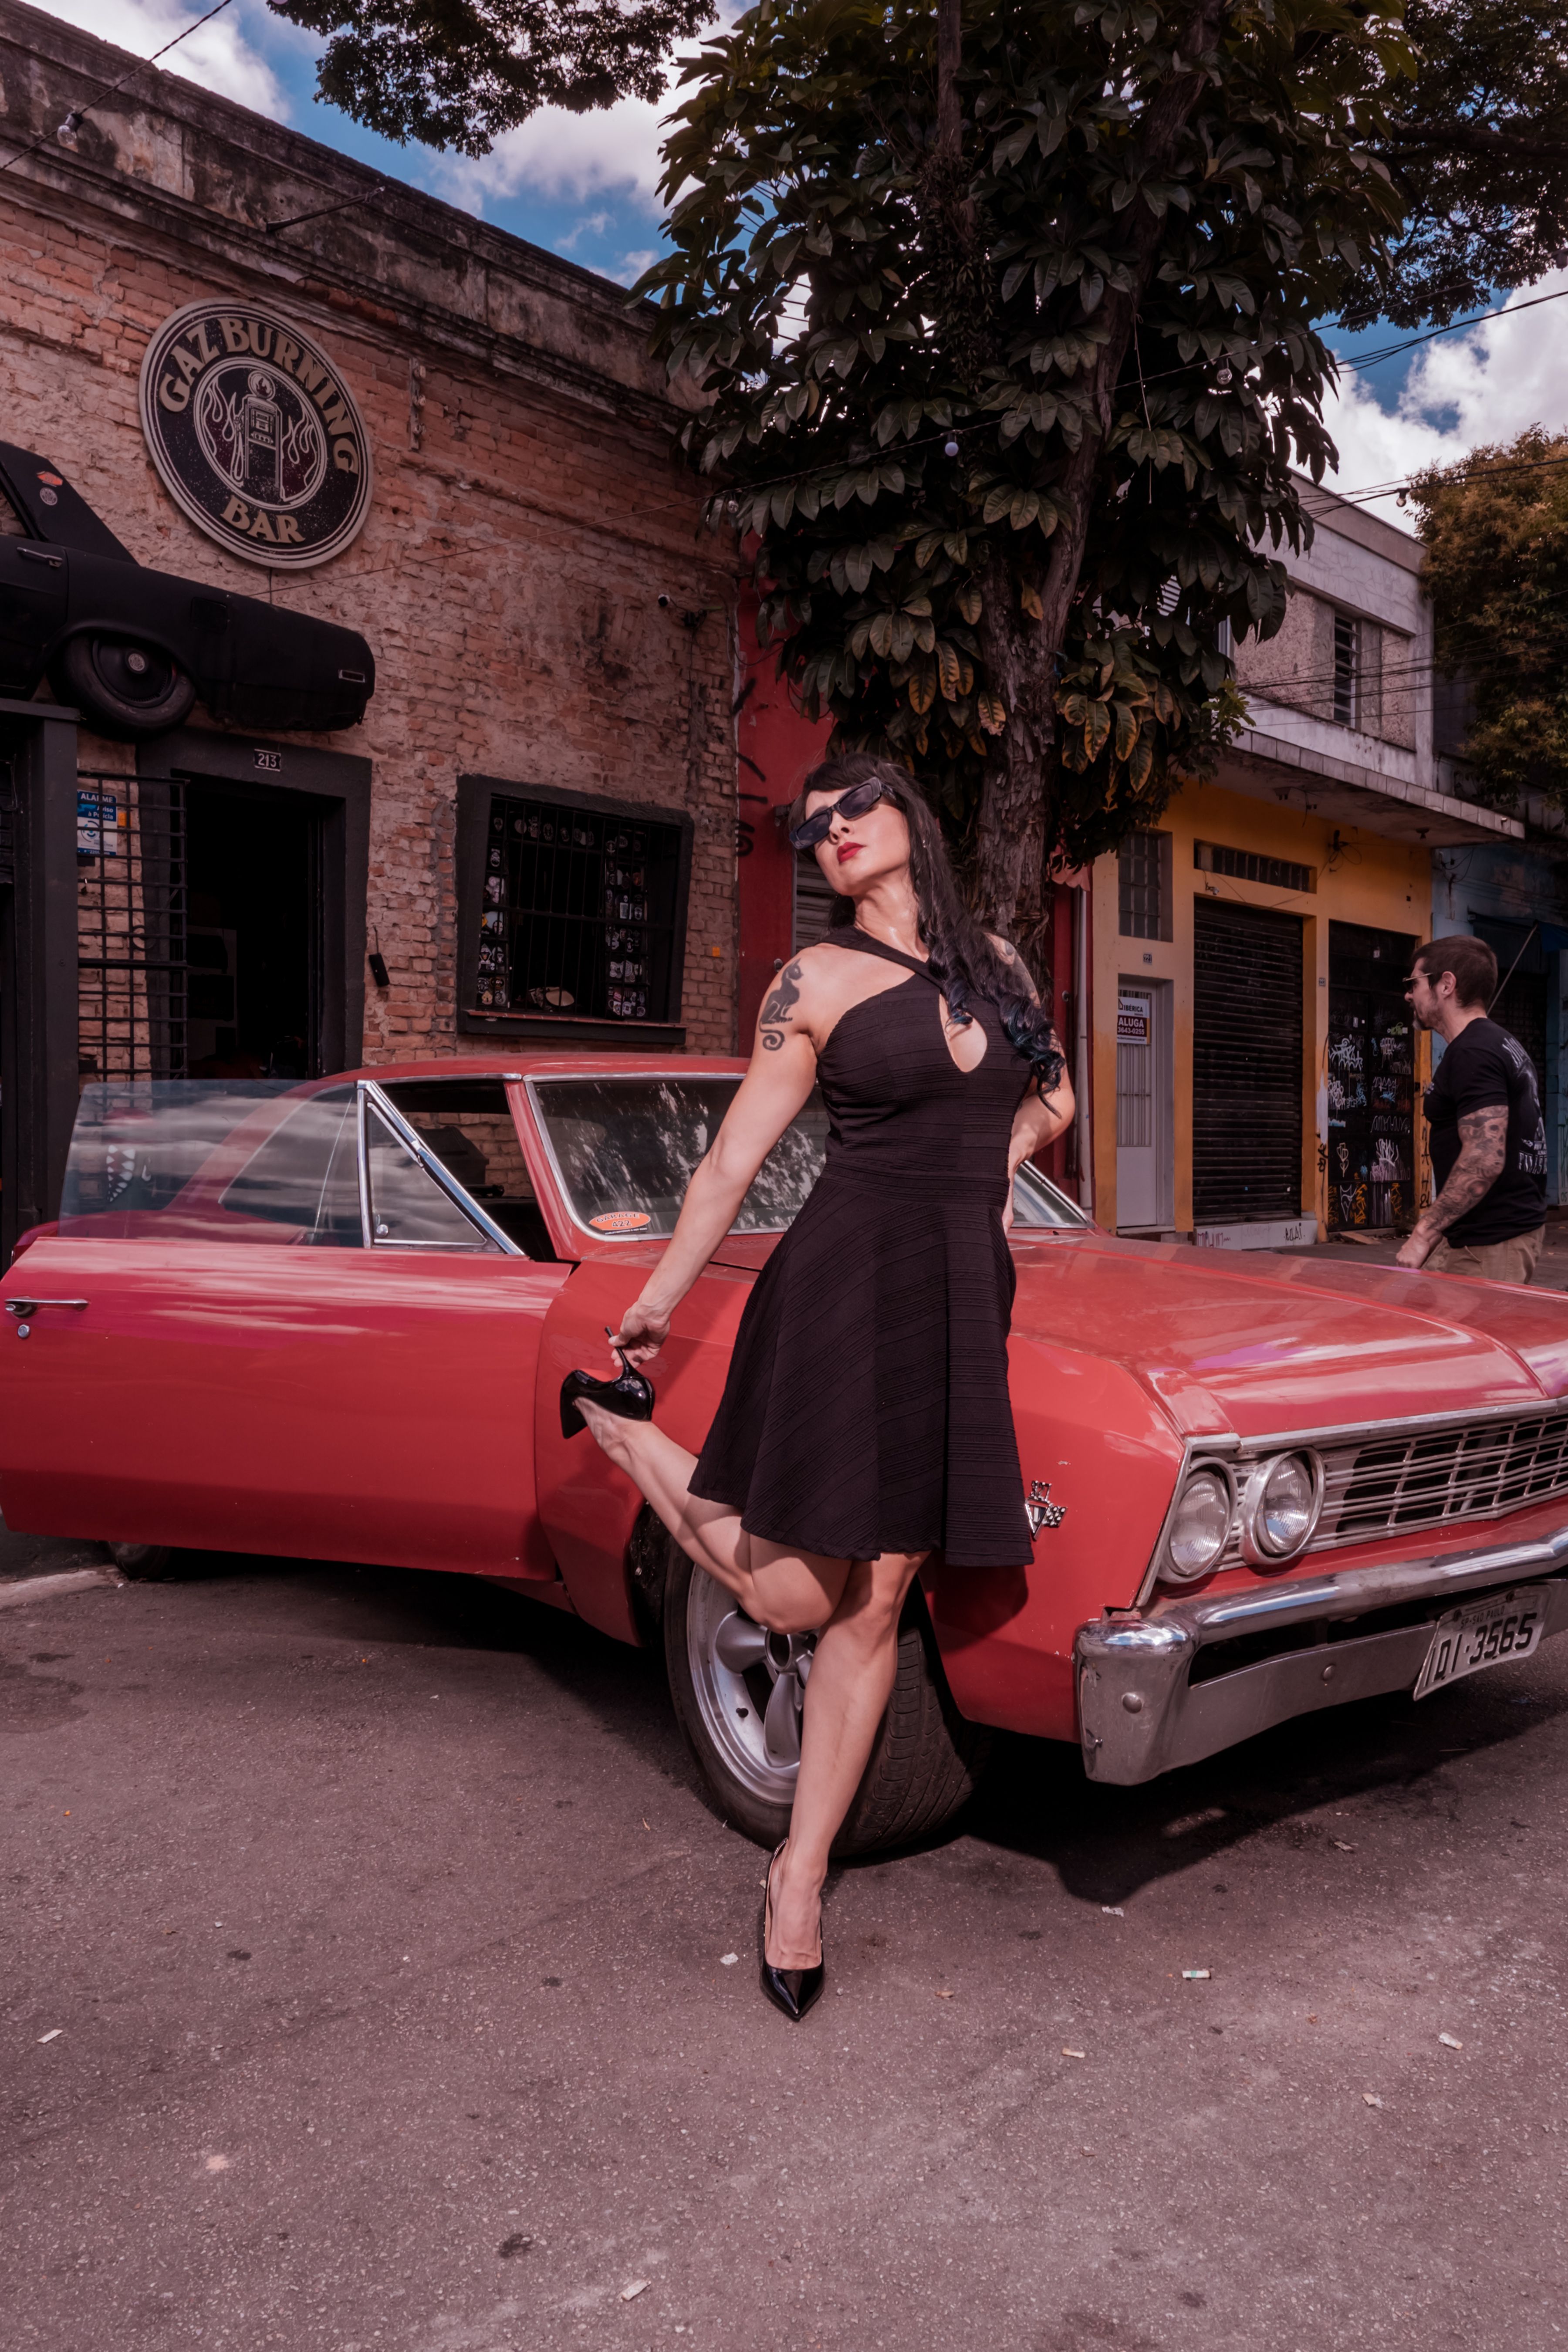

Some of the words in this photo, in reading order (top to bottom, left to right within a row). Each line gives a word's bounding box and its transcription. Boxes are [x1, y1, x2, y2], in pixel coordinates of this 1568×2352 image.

[159, 325, 221, 413] GAZ
[219, 318, 359, 474] BURNING
[220, 495, 305, 544] BAR
[258, 753, 277, 767] 213
[1123, 1004, 1143, 1012] IBÉRICA
[1118, 1017, 1144, 1028] ALUGA
[596, 1213, 639, 1222] GARAGE
